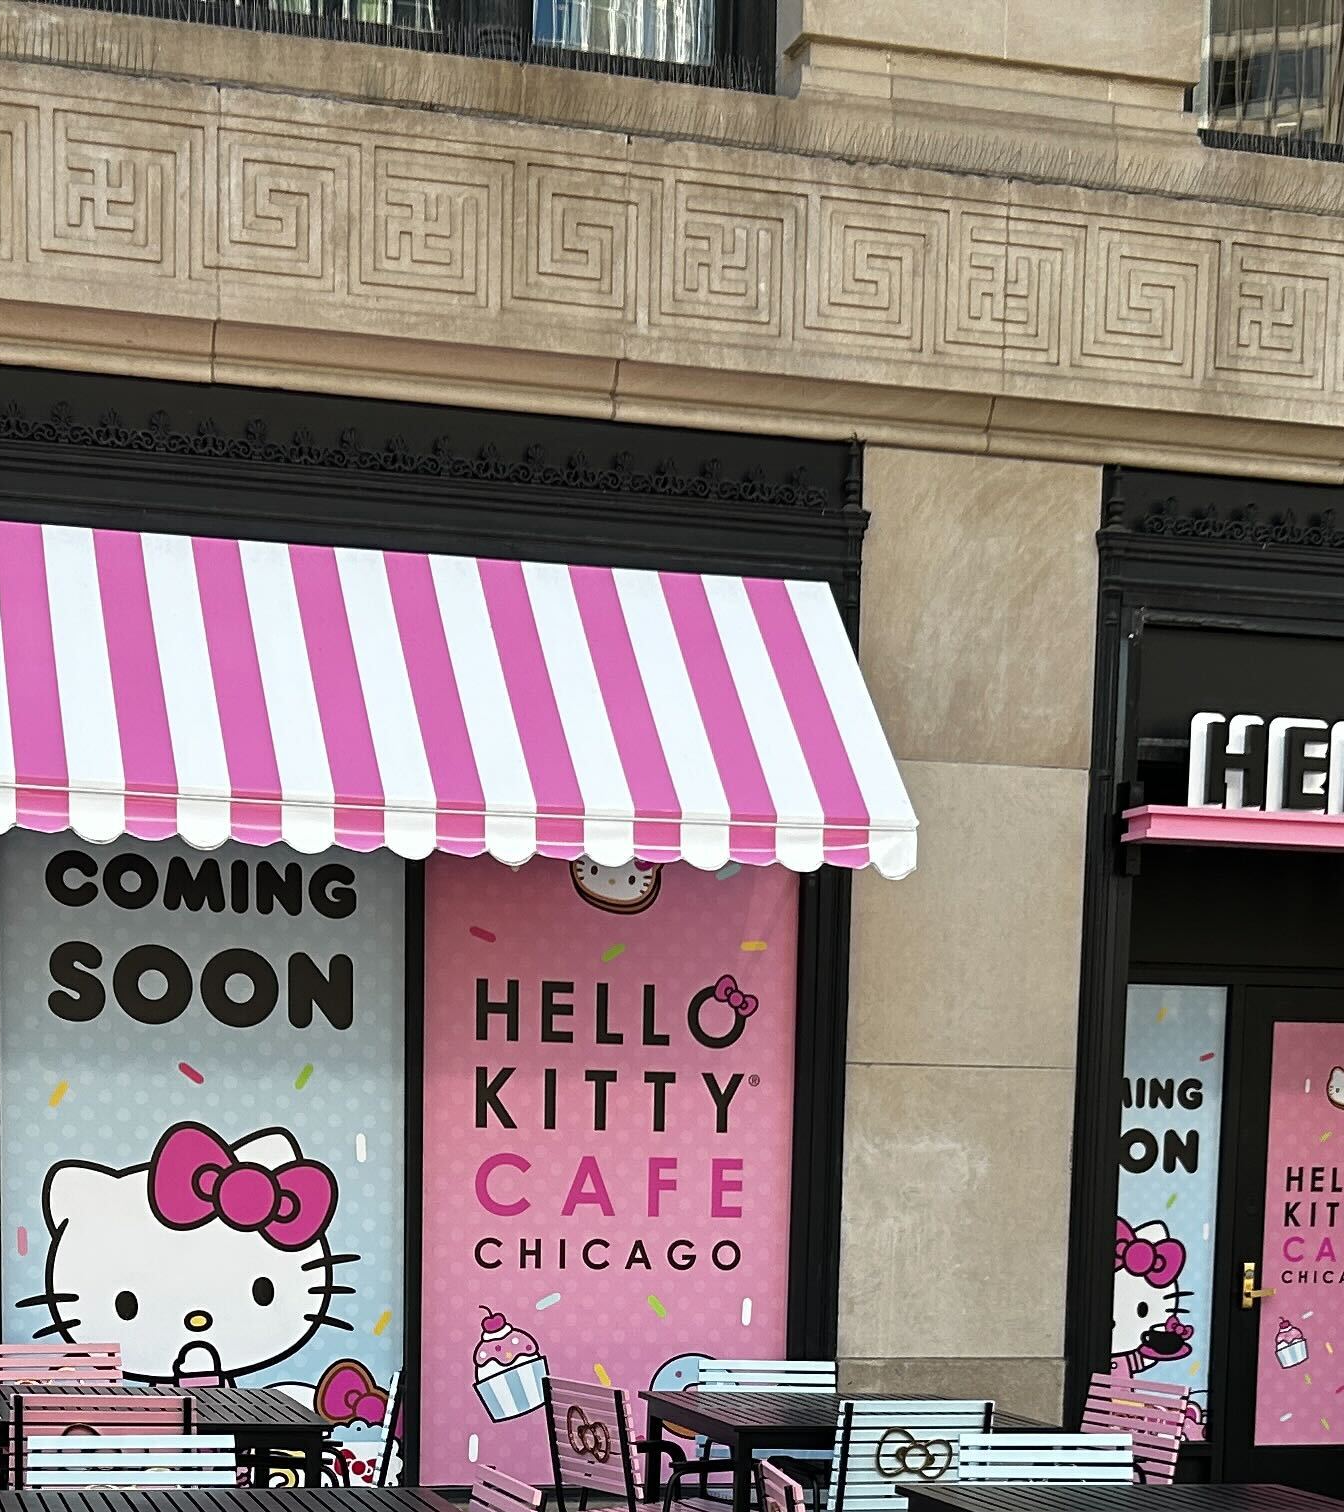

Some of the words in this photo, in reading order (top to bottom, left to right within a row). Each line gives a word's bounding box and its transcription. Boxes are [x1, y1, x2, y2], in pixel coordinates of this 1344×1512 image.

[45, 850, 357, 920] COMING
[47, 941, 353, 1030] SOON
[475, 978, 751, 1049] HELLO
[474, 1153, 744, 1218] CAFE
[474, 1237, 742, 1271] CHICAGO
